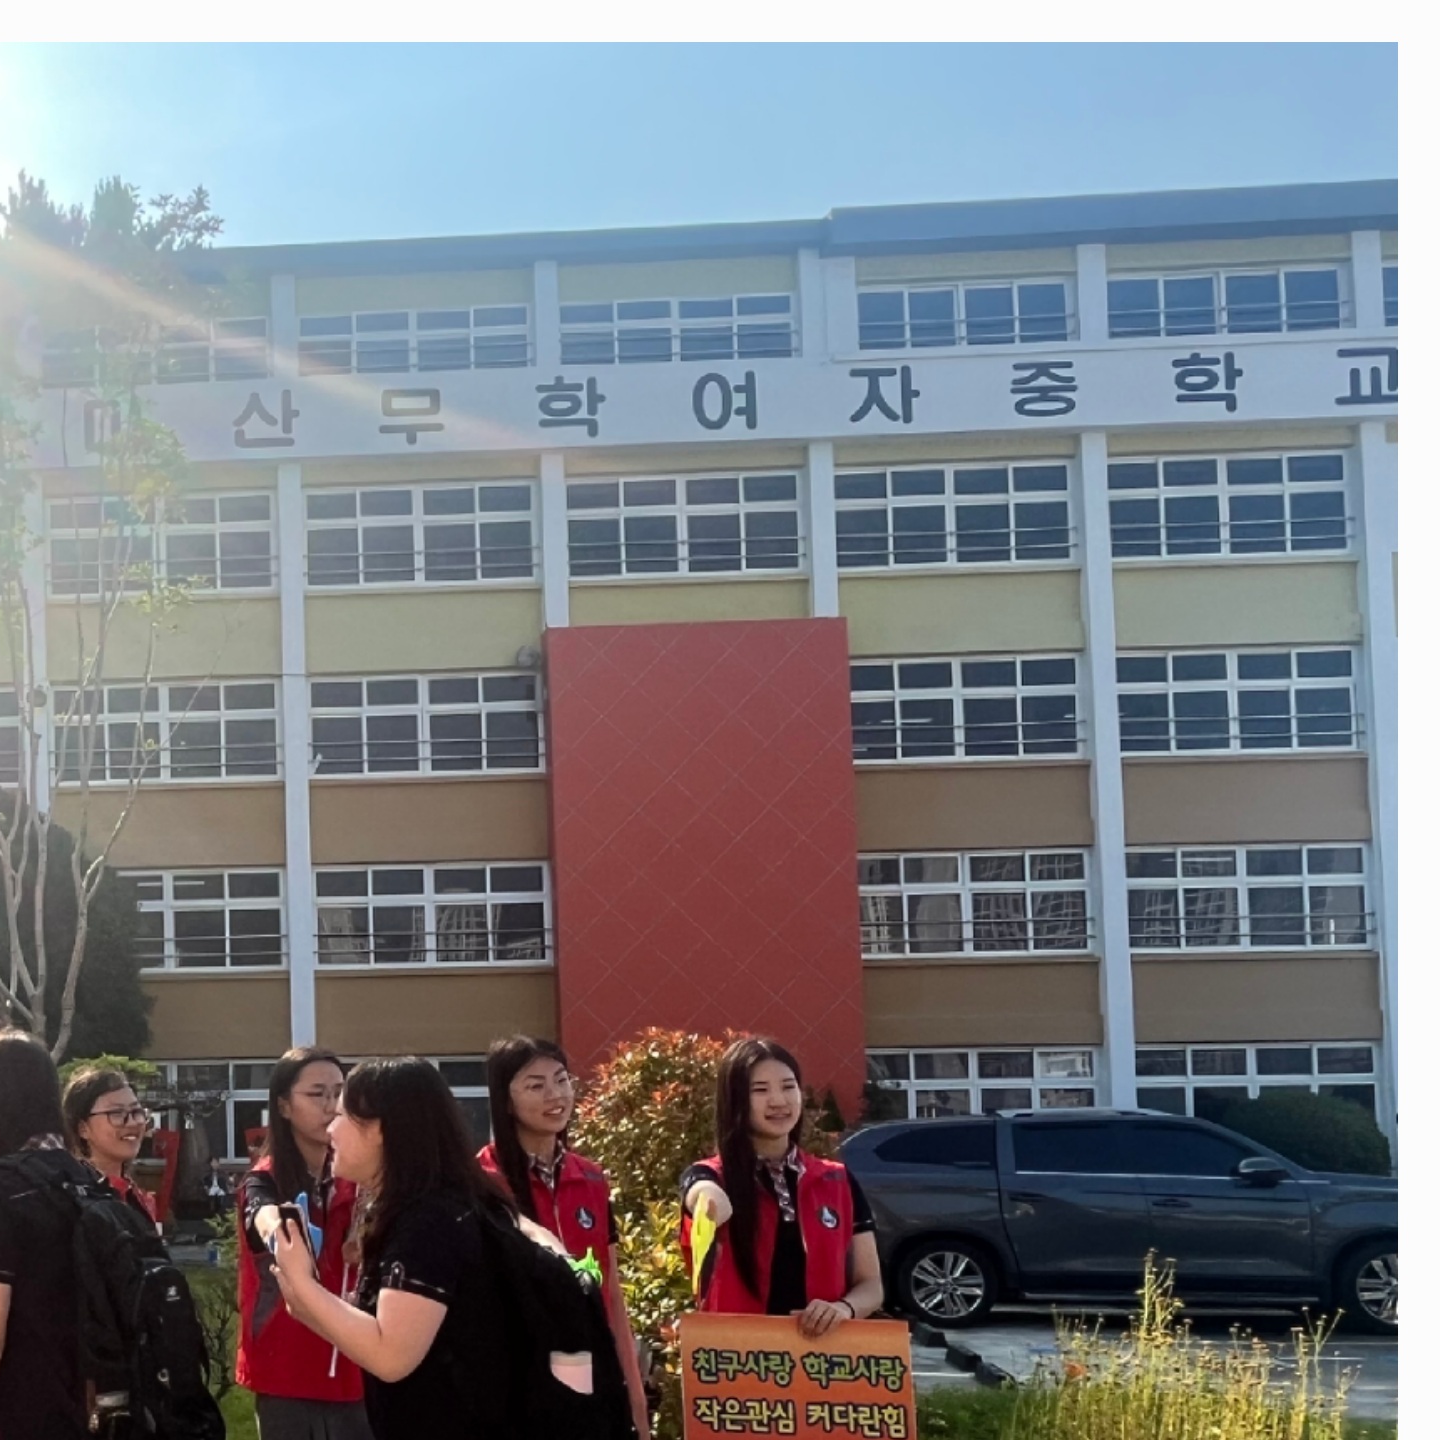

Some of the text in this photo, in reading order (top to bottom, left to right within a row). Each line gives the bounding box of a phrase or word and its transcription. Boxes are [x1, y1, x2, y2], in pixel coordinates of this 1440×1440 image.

[692, 1348, 907, 1392] 친구사랑 학교사랑
[694, 1398, 907, 1440] 작은관심 커다란힘
